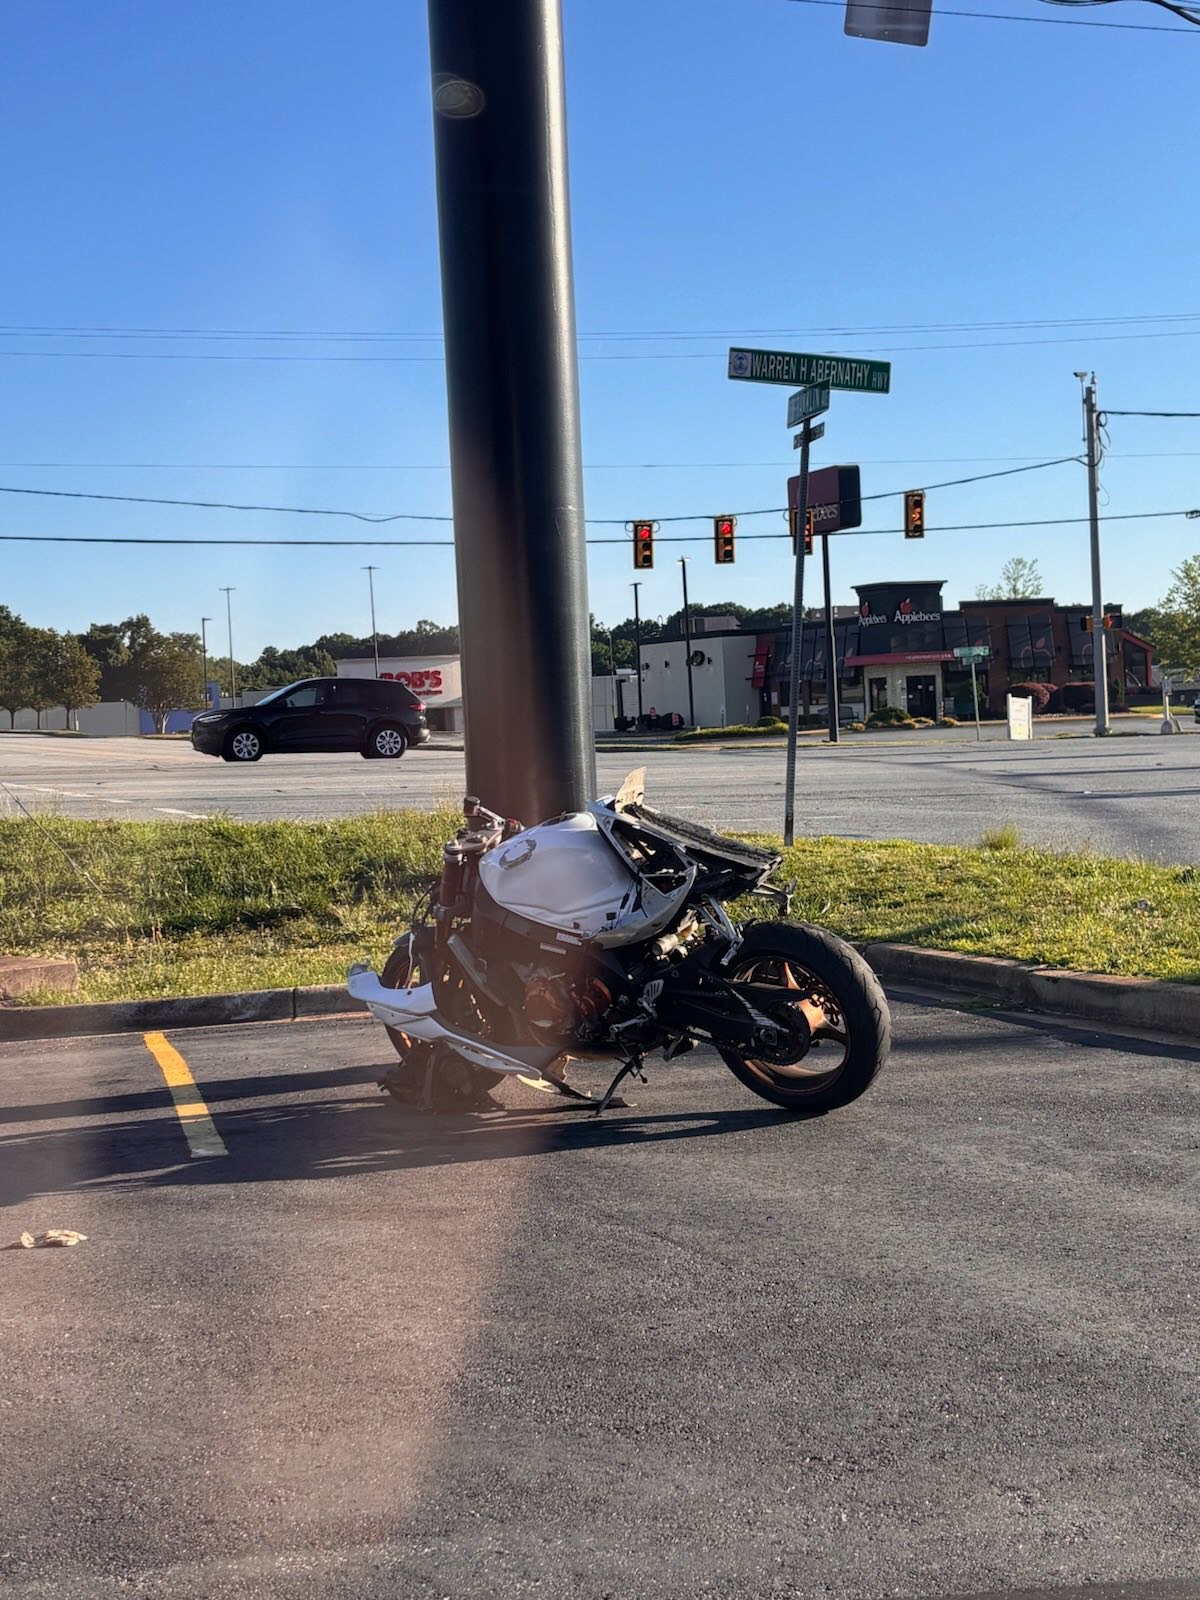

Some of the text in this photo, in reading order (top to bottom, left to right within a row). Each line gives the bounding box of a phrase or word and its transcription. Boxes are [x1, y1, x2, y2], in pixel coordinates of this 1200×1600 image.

[752, 353, 888, 389] WARREN H ABERNATHY HWY
